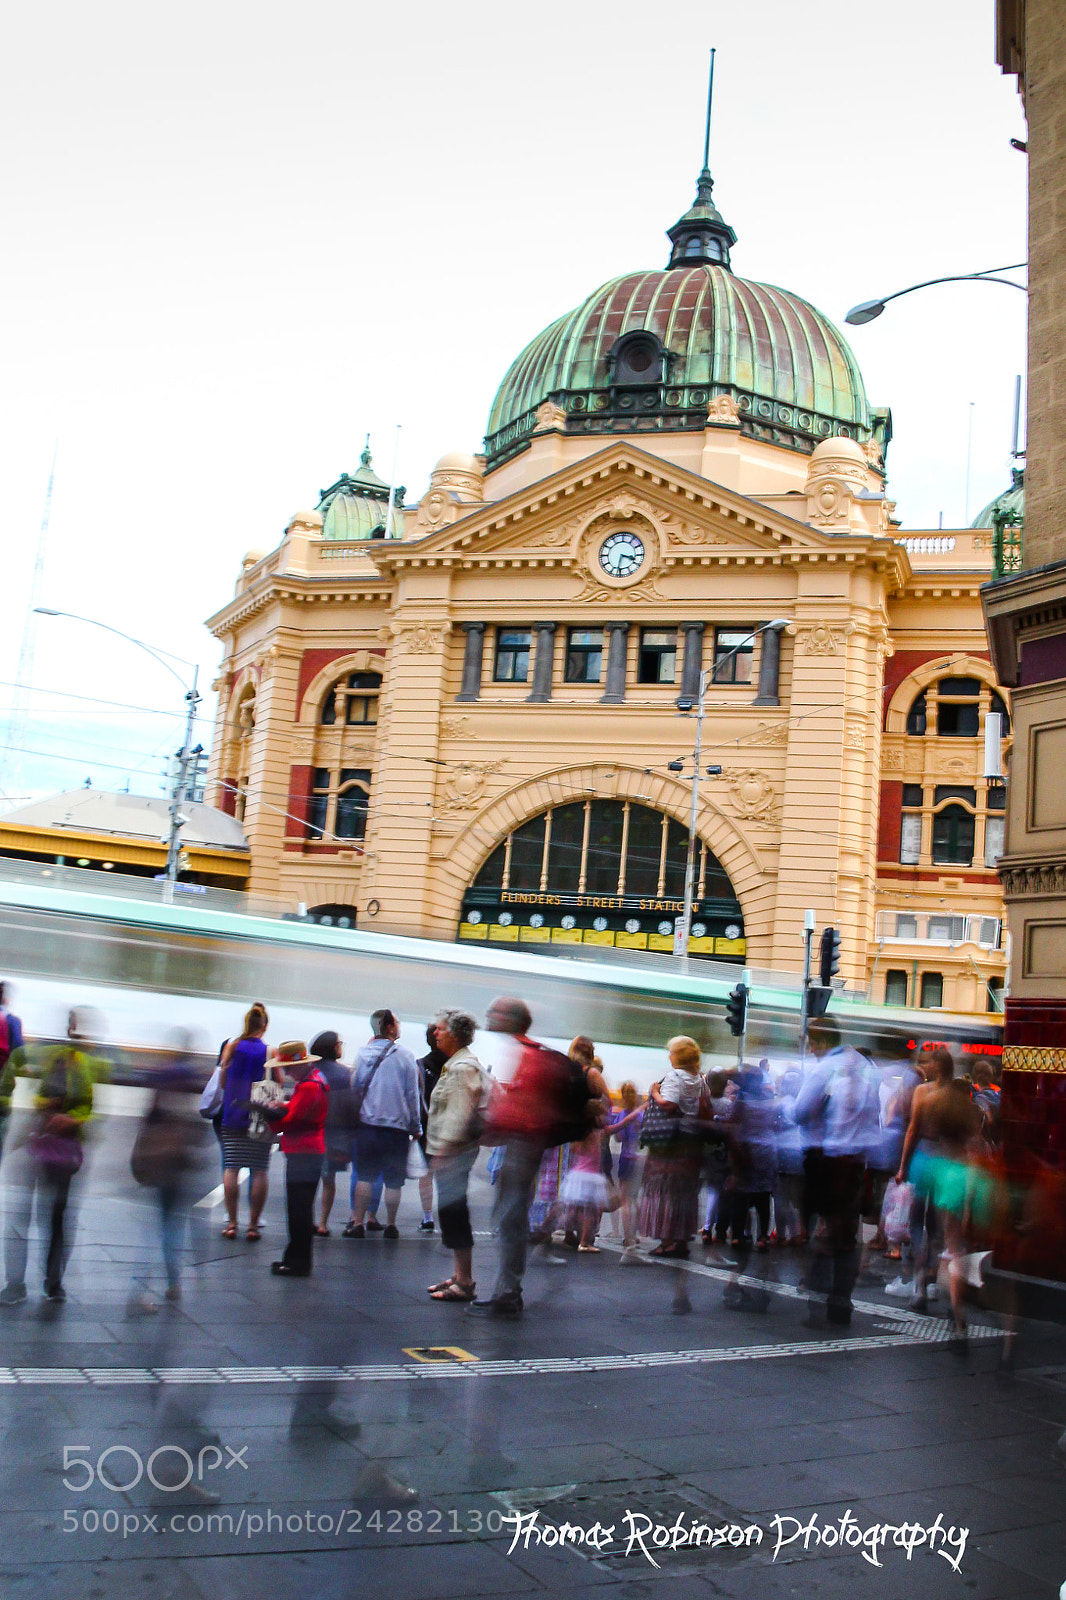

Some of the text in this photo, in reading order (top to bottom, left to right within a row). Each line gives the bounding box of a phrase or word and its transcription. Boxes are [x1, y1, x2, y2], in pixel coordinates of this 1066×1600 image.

[501, 892, 699, 912] FLINDERS STREET STATION
